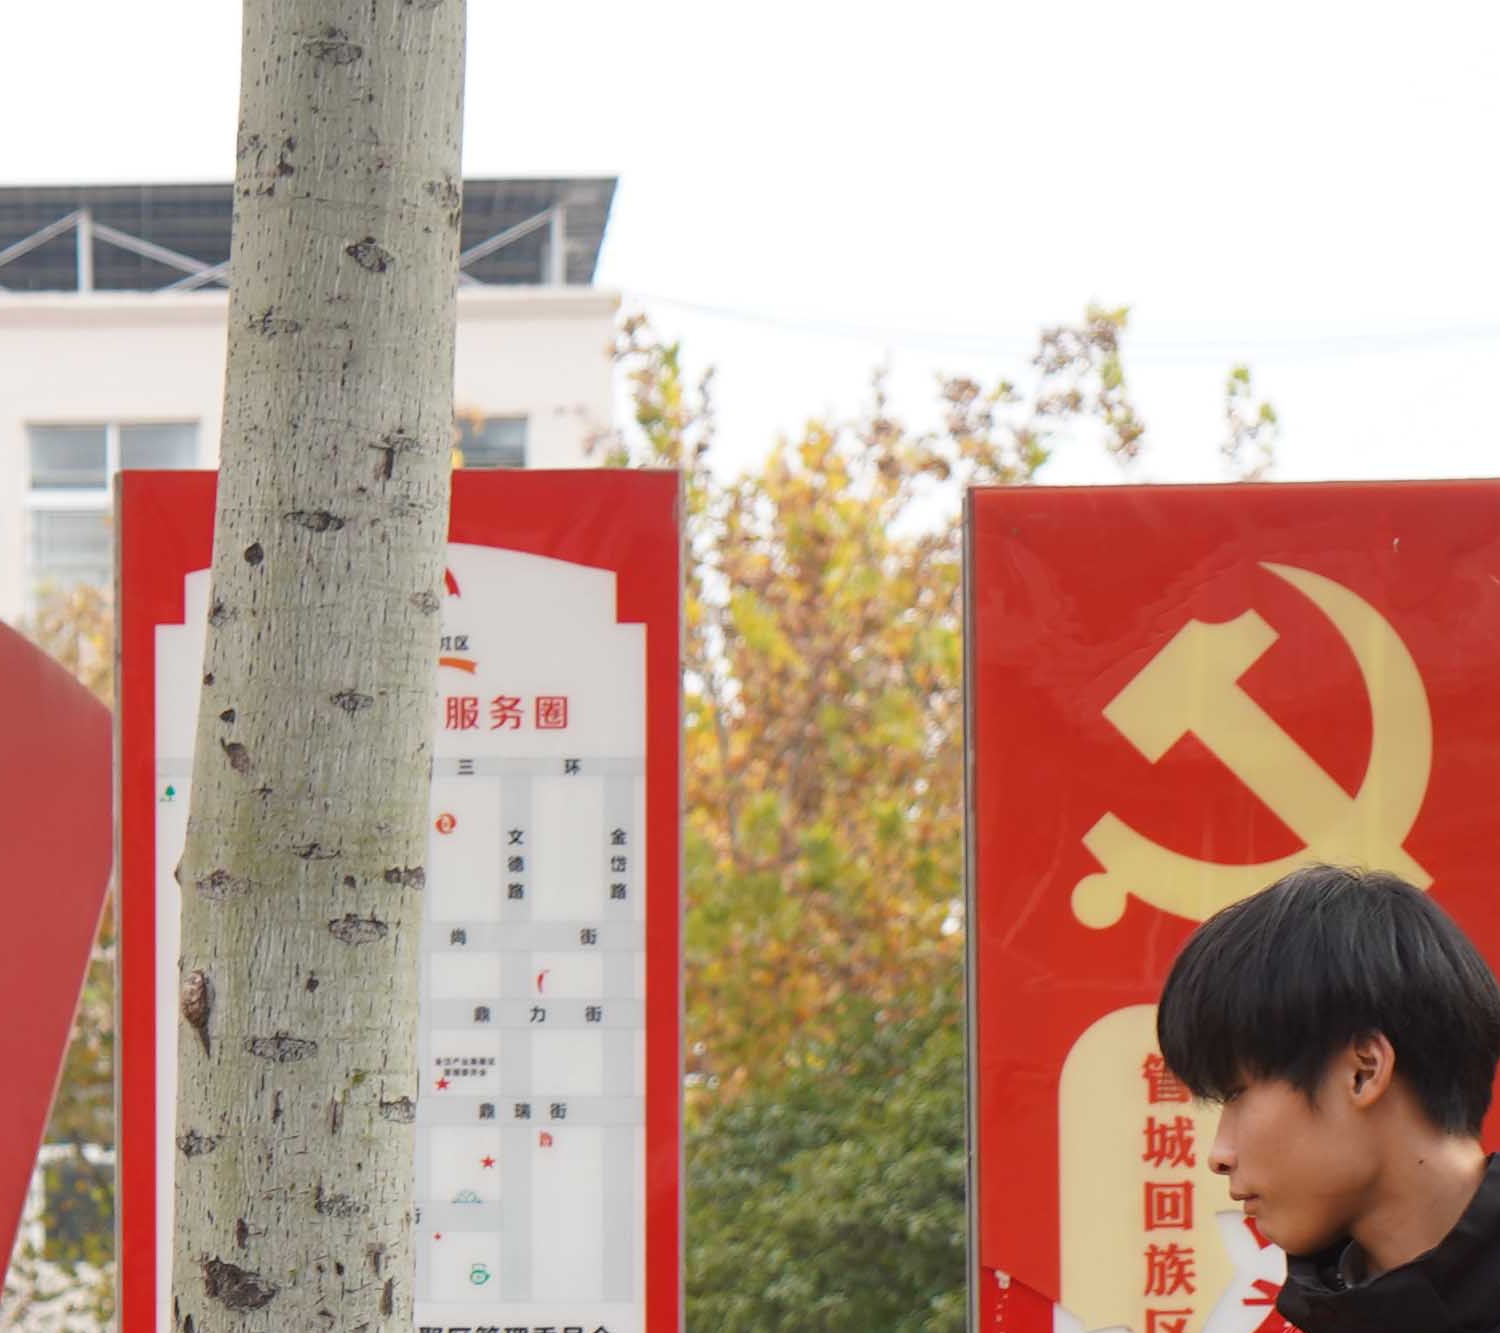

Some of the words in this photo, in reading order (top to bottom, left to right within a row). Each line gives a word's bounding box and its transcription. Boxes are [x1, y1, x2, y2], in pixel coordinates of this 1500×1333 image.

[445, 695, 569, 730] 服务圈
[507, 828, 525, 900] 文德路
